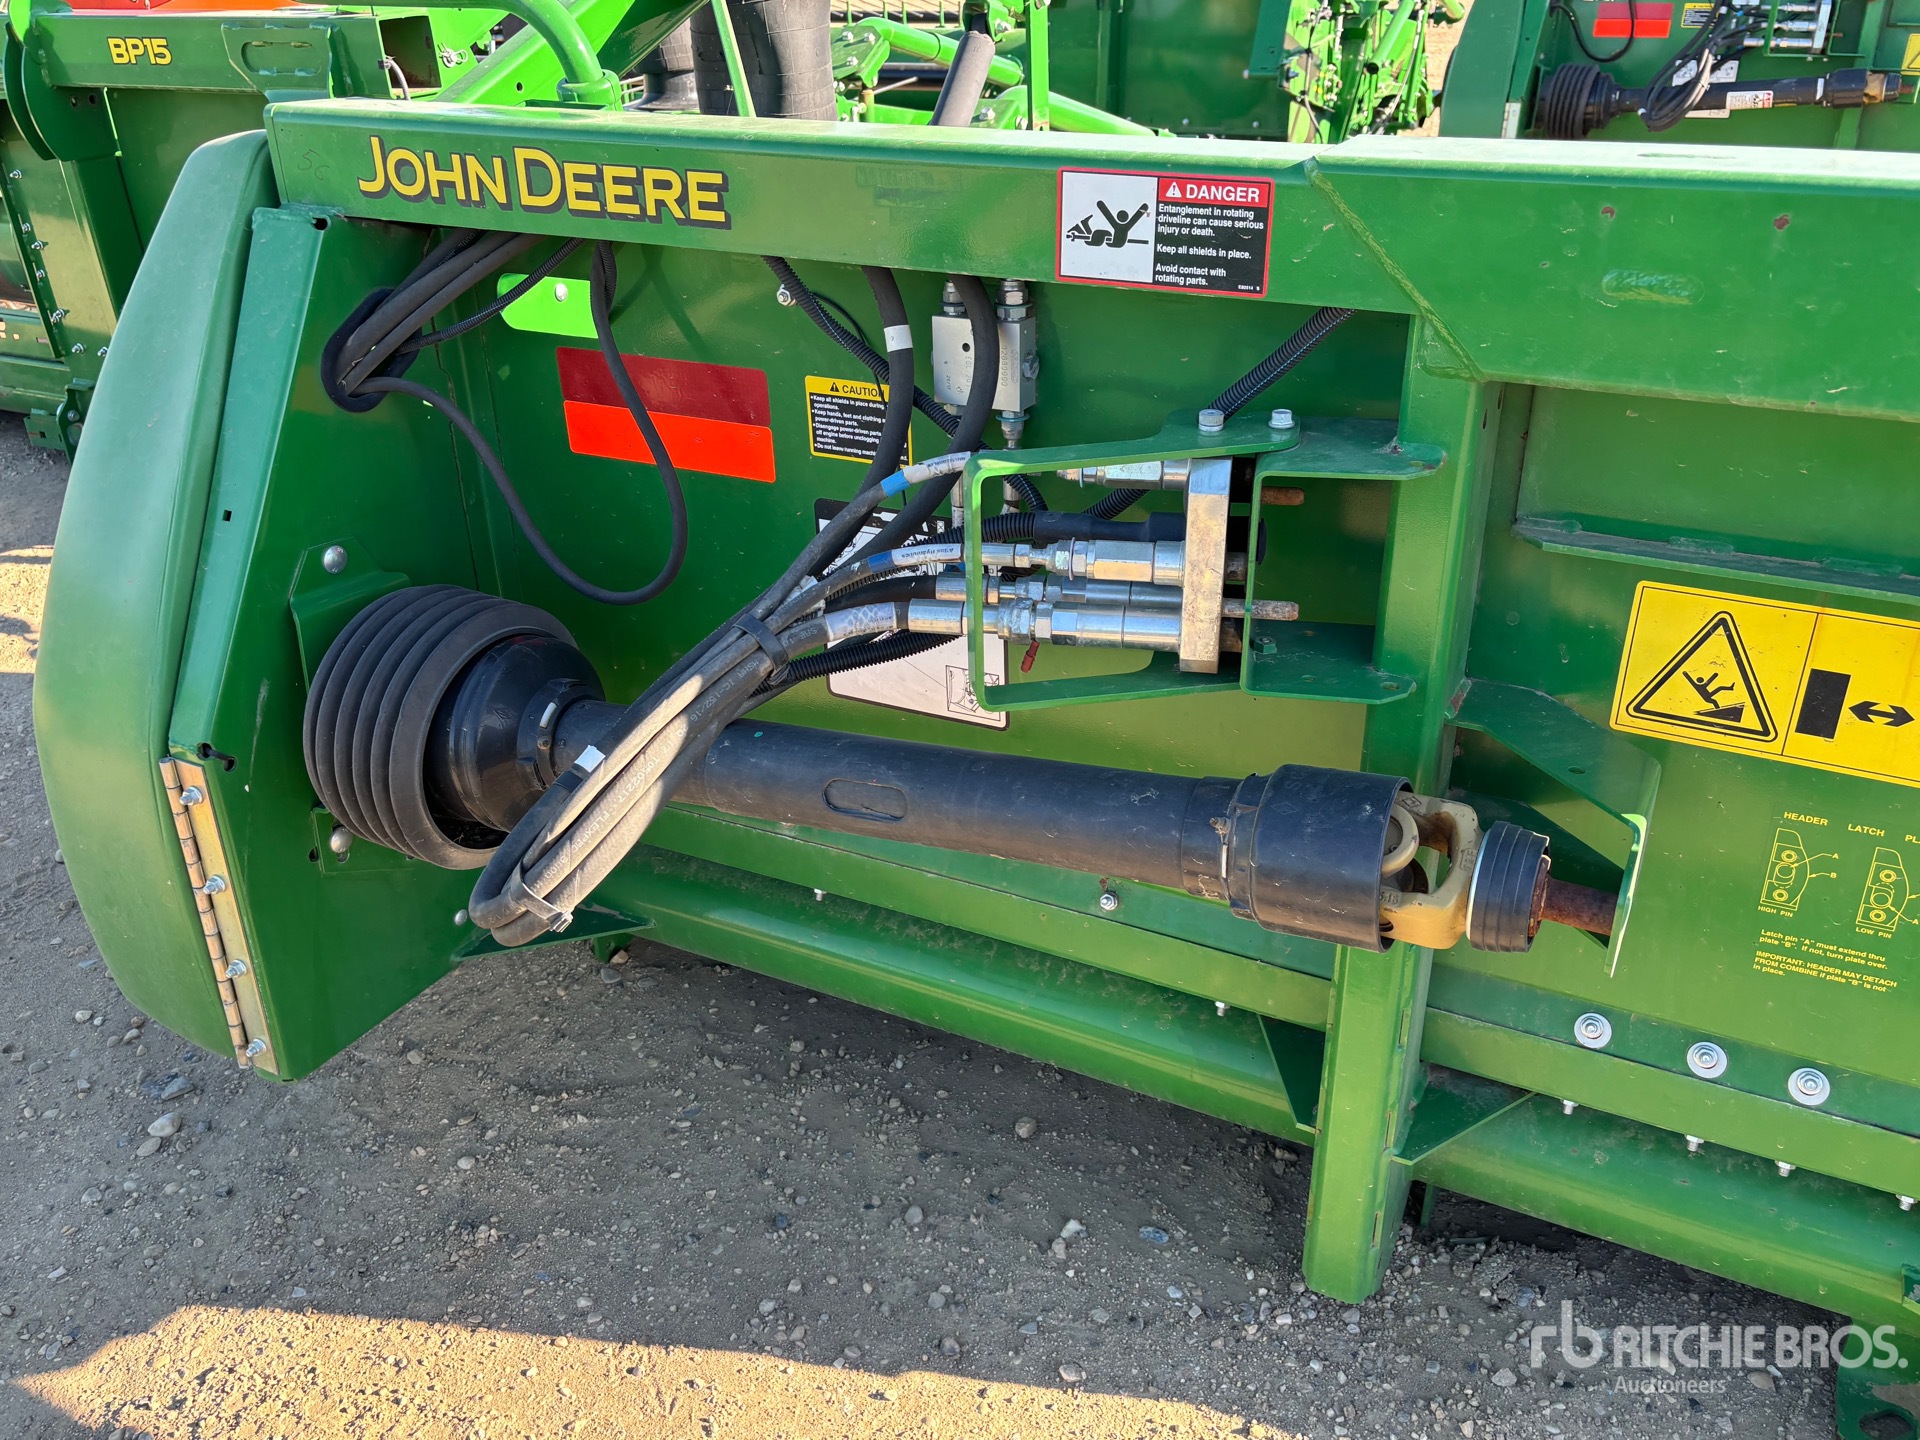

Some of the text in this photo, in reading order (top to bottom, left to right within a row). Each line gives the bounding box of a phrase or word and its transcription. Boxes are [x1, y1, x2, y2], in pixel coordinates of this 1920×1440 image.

[107, 37, 172, 65] BP15
[357, 135, 729, 228] JOHN DEERE
[1186, 184, 1260, 202] DANGER
[1158, 203, 1254, 220] Entanglement in rotating
[1158, 214, 1191, 225] driveline
[1208, 220, 1233, 228] cause
[1234, 220, 1264, 229] serious
[1157, 224, 1179, 235] injury
[1191, 227, 1215, 237] death.
[1157, 244, 1252, 259] Keep all shields in place.
[1156, 263, 1226, 277] Avoid contact with
[1155, 274, 1208, 286] rotating parts.
[813, 402, 840, 410] operations.
[815, 416, 844, 424] power-driven
[827, 410, 843, 418] hands,
[862, 415, 881, 424] clothing
[815, 422, 840, 431] Disengage
[840, 427, 869, 435] power-driven
[839, 432, 854, 440] before
[854, 434, 880, 444] unclogging
[844, 447, 862, 455] running
[736, 659, 760, 678] MSHA
[1783, 811, 1920, 845] HEADER LATCH PL
[1757, 905, 1793, 918] HIGH PIN
[1855, 926, 1892, 939] LOW PIN
[1761, 929, 1783, 940] Latch
[1785, 934, 1798, 943] pin
[1816, 942, 1837, 951] must
[1838, 946, 1867, 958] extend
[1868, 952, 1886, 962] thru
[1759, 936, 1779, 946] plate
[1809, 947, 1825, 957] not,
[1826, 951, 1844, 960] turn
[1845, 955, 1866, 965] plate
[1867, 961, 1888, 970] over.
[1754, 957, 1779, 968] FROM
[1779, 962, 1818, 977] COMBINE
[1826, 973, 1846, 984] plate
[1872, 985, 1887, 993] not
[1756, 950, 1897, 988] IMPORTANT: HEADER MAY DETACH
[1762, 966, 1786, 977] place.
